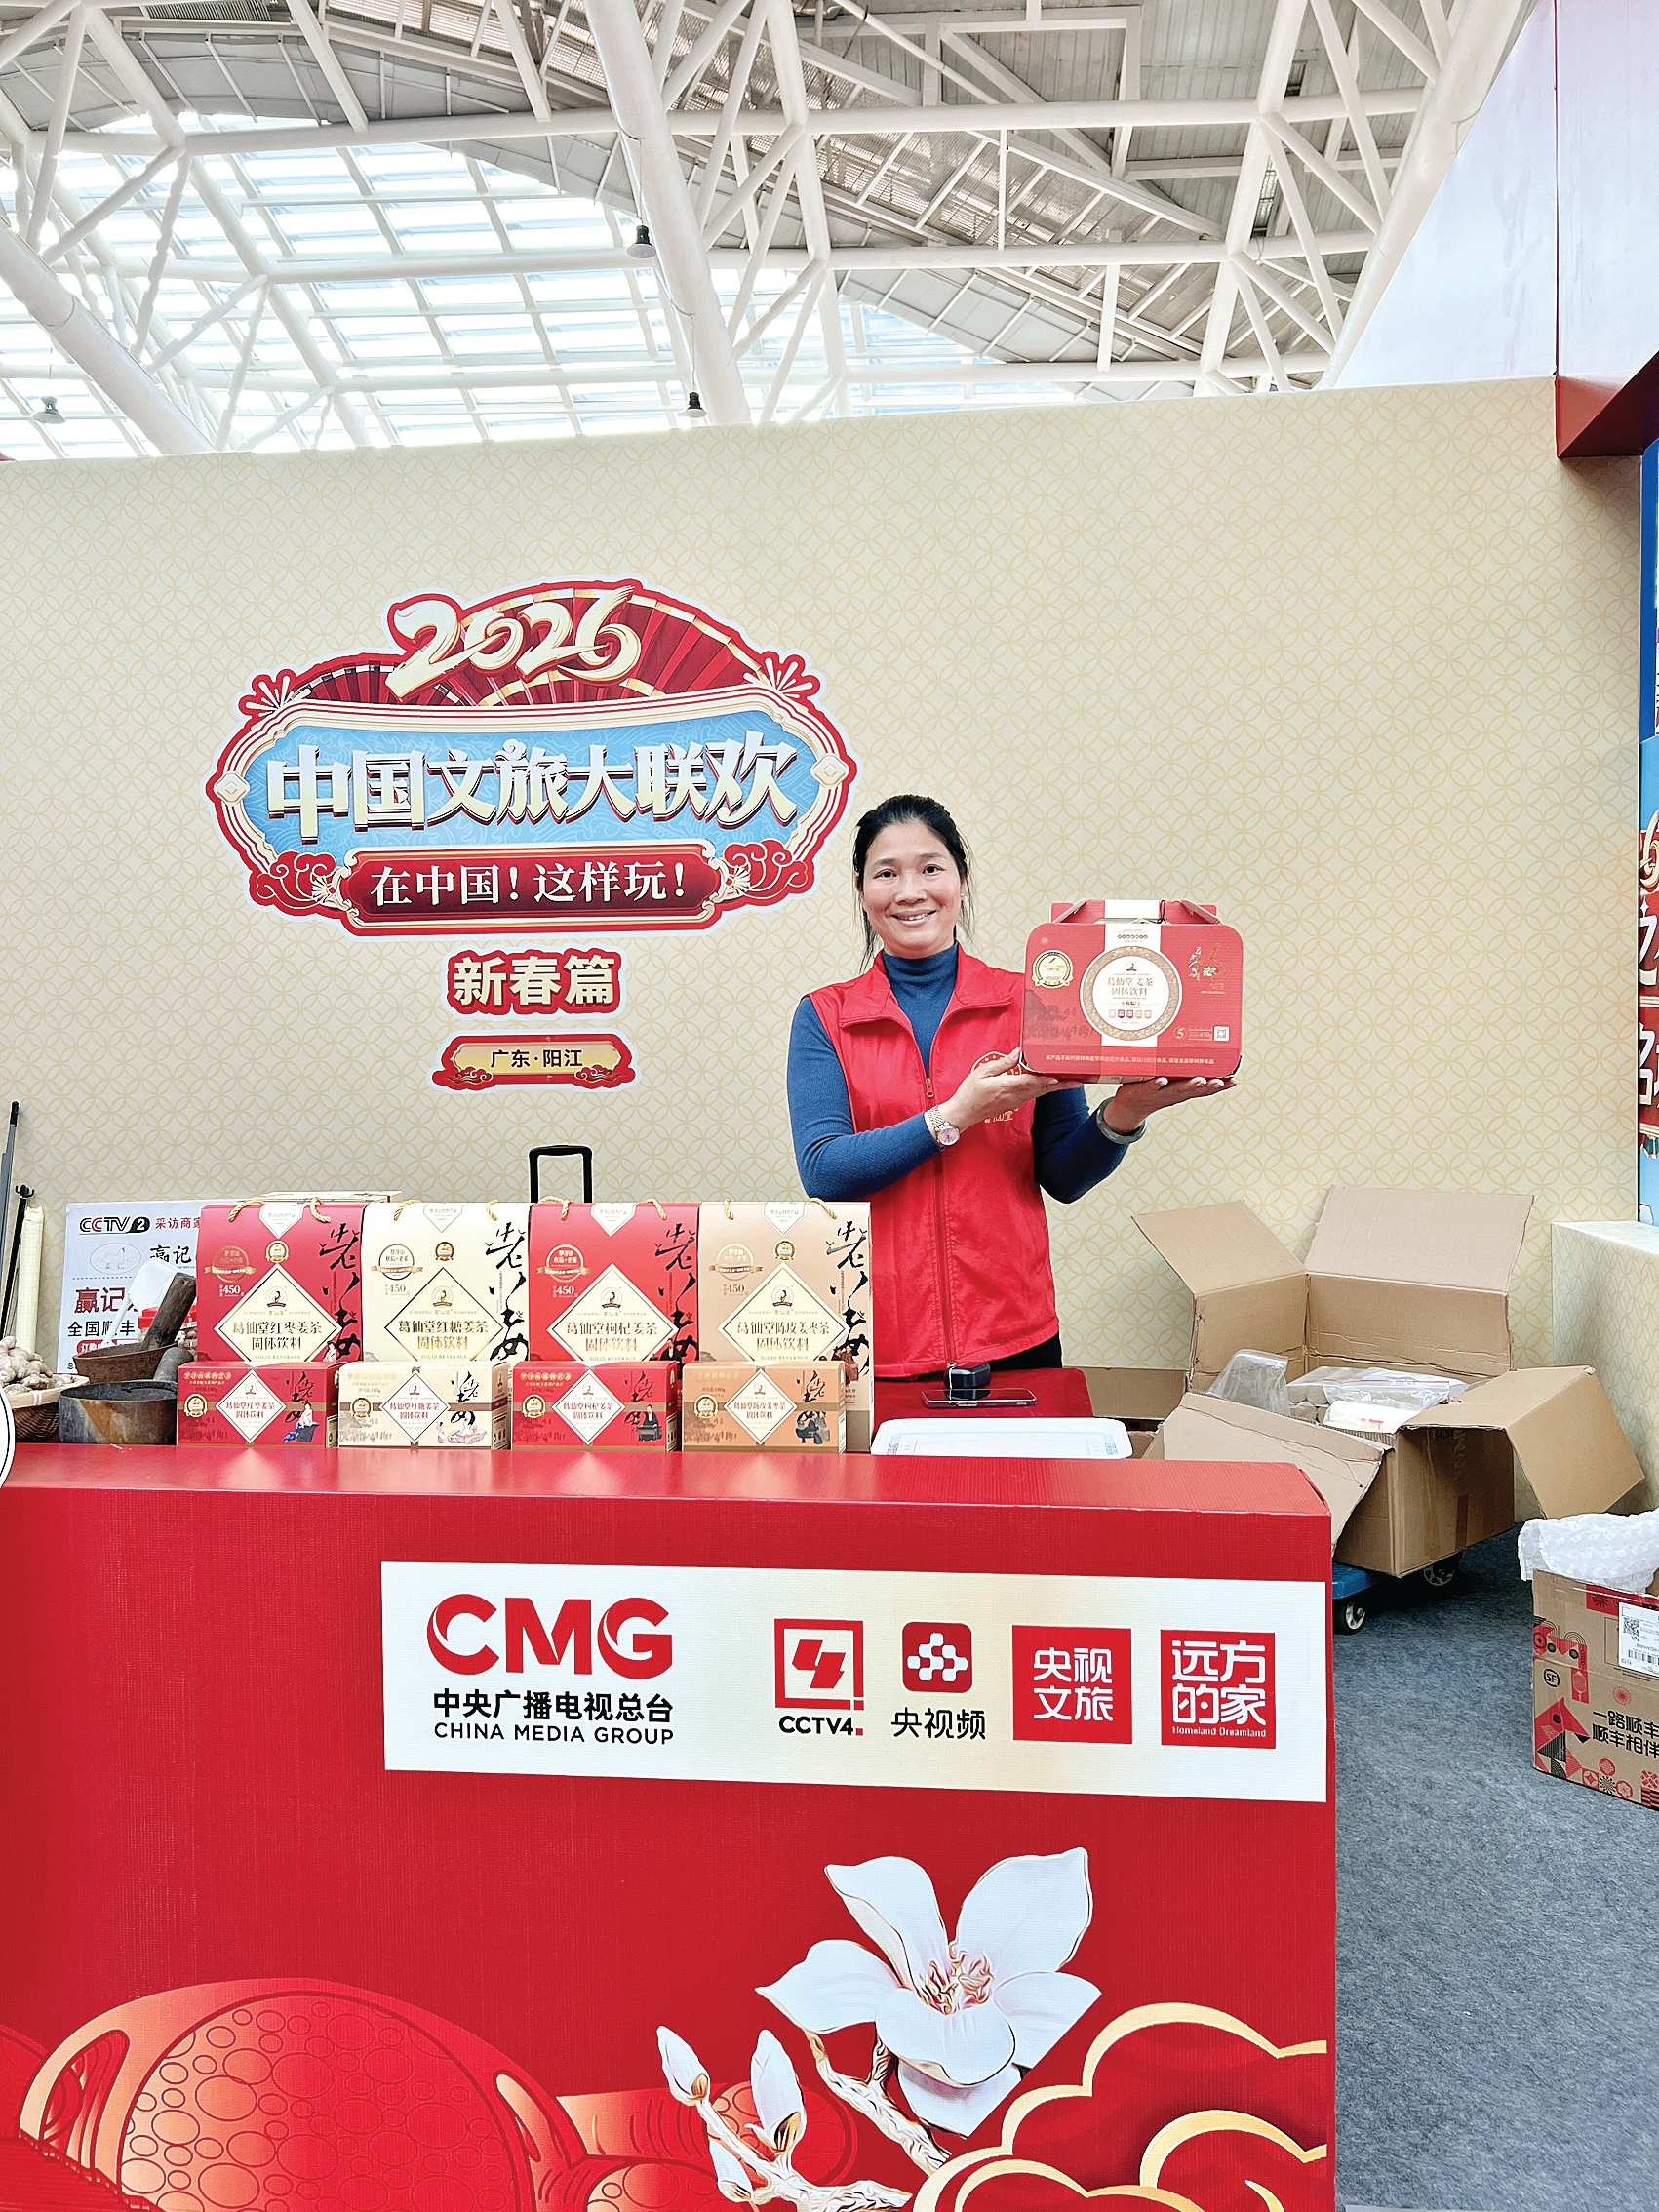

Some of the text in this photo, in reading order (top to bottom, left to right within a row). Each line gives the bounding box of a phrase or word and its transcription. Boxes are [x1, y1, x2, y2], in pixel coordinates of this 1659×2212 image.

[386, 585, 641, 699] 2026
[266, 731, 798, 845] 中国文旅大联欢
[454, 956, 616, 1007] 新春篇
[223, 1285, 241, 1294] 450
[389, 1284, 406, 1293] 450
[556, 1285, 574, 1295] 450
[727, 1284, 745, 1293] 450
[74, 1287, 138, 1313] 赢记
[232, 1321, 322, 1335] 葛仙堂红枣姜茶
[398, 1321, 489, 1333] 葛仙堂红糖姜茶
[566, 1322, 658, 1335] 葛仙堂枸杞姜茶
[252, 1337, 301, 1351] 固体饮料
[417, 1336, 468, 1350] 固体饮料
[586, 1338, 637, 1352] 固体饮料
[756, 1337, 809, 1352] 固体饮料
[427, 1594, 672, 1679] CMG
[1033, 1647, 1112, 1683] 央视
[1171, 1639, 1266, 1684] 远方
[1546, 1673, 1557, 1682] SF
[433, 1688, 674, 1723] 中央广播电视总台
[1033, 1685, 1113, 1721] 文旅
[1171, 1683, 1266, 1726] 的家
[434, 1721, 674, 1745] CHINA MEDIA GROUP
[891, 1707, 985, 1740] 央视频
[1172, 1726, 1266, 1738] Homeland Dreamland
[1593, 1710, 1659, 1740] 一路顺丰
